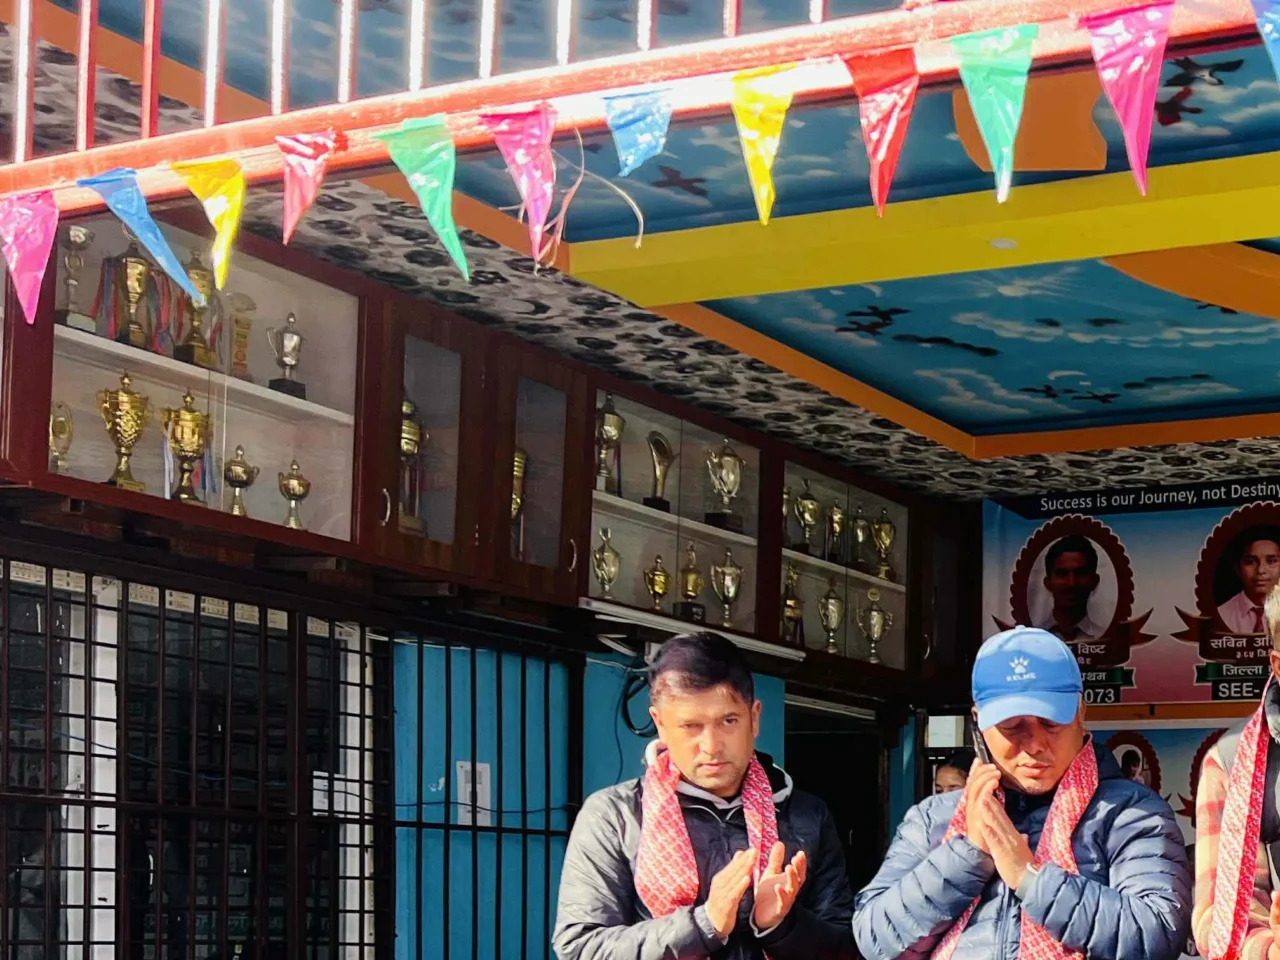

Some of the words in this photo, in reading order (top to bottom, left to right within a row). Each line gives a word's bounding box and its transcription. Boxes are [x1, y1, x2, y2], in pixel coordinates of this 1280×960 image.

[1041, 496, 1092, 511] Success
[1097, 494, 1107, 507] is
[1111, 494, 1135, 505] our
[1139, 490, 1197, 505] Journey,
[1202, 487, 1226, 500] not
[1222, 664, 1263, 676] जिल्ला
[1084, 689, 1115, 703] 073
[1219, 682, 1260, 697] SEE-
